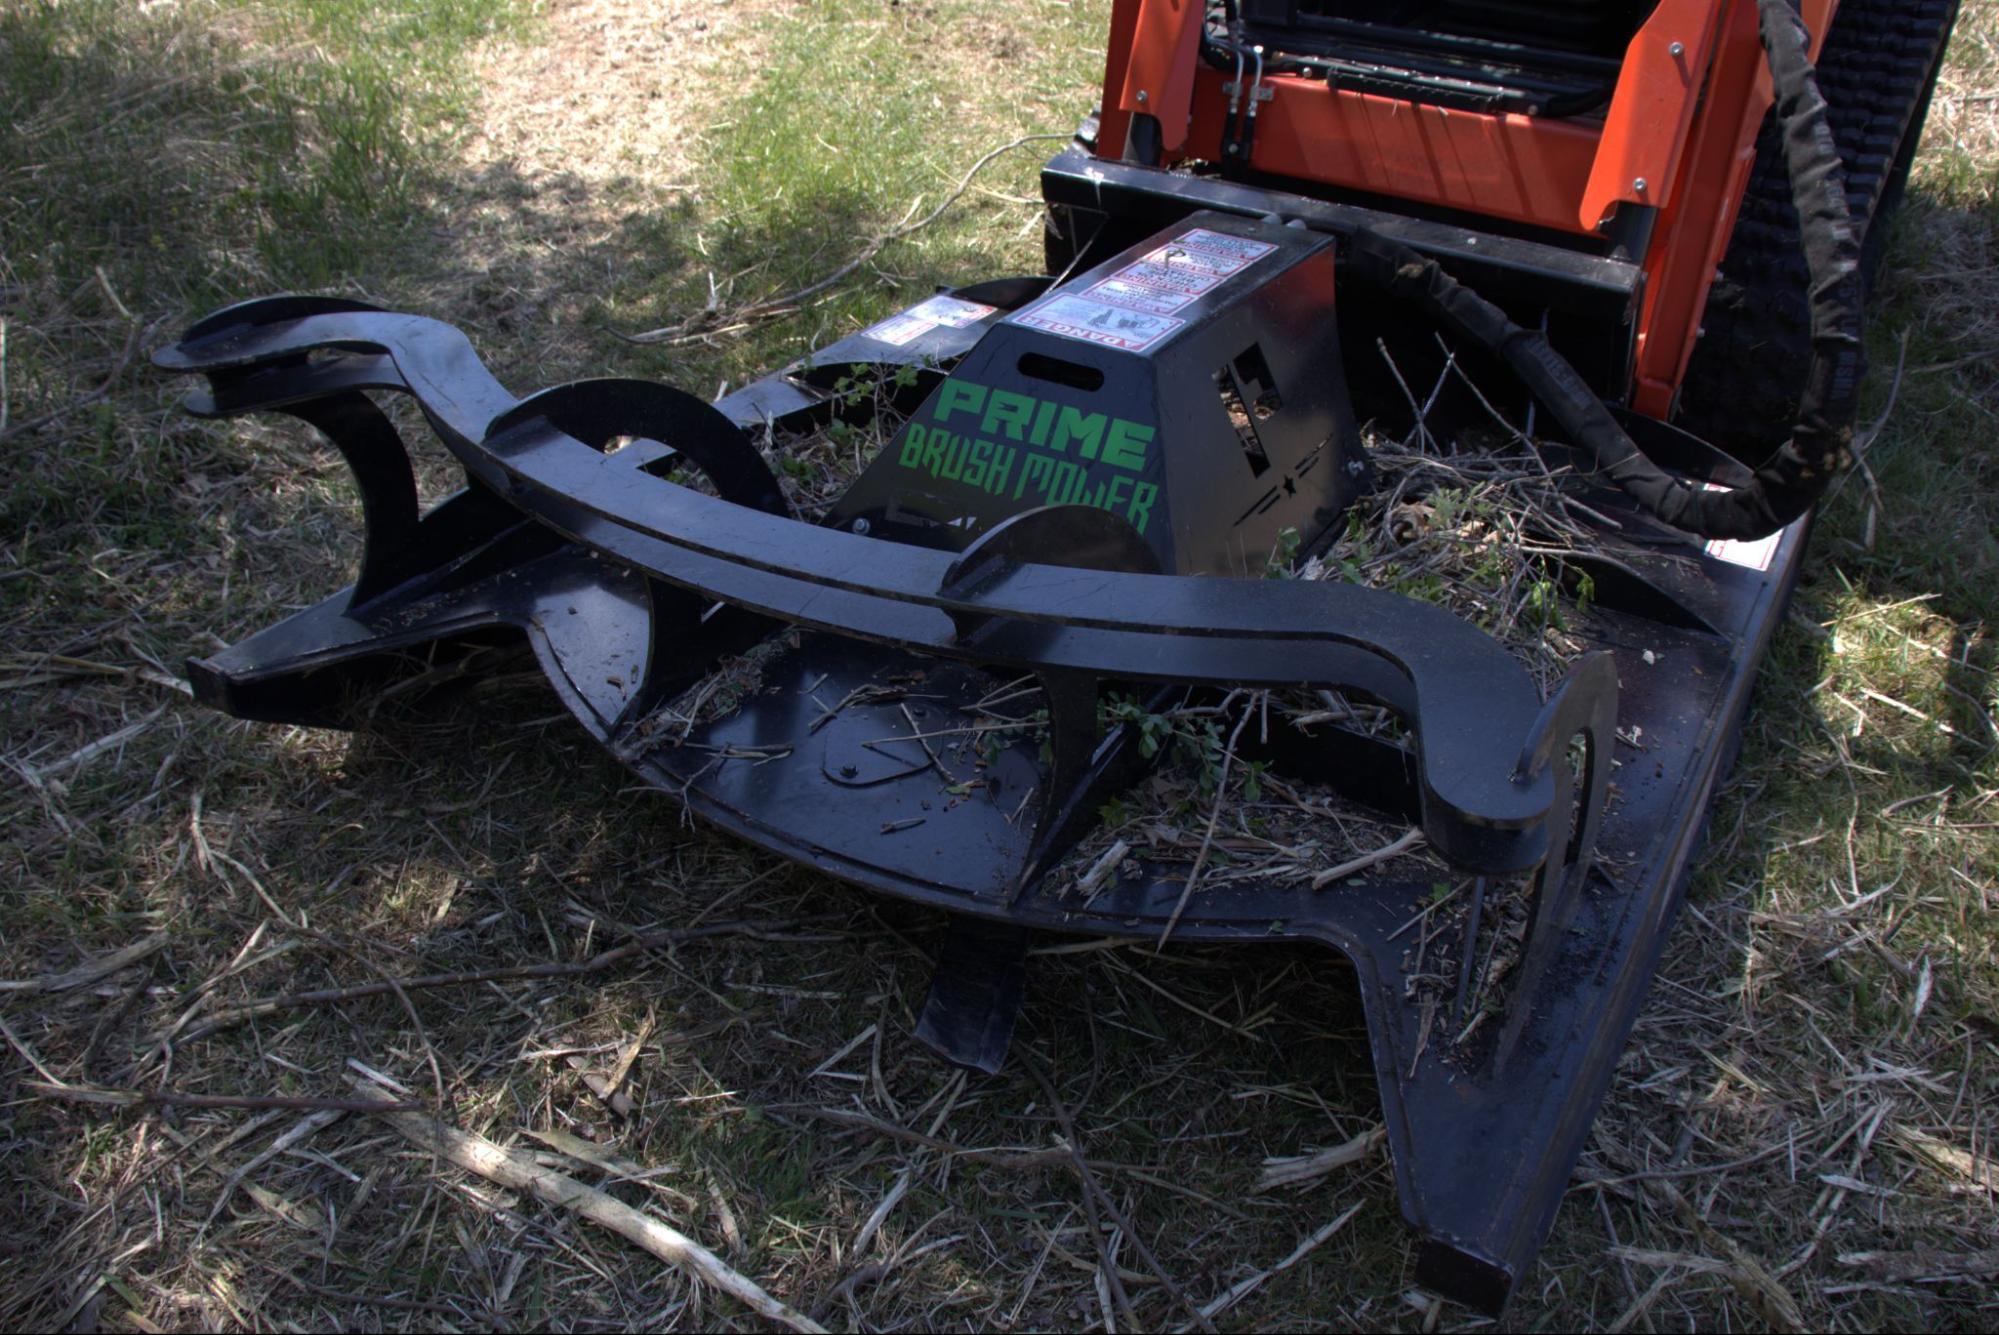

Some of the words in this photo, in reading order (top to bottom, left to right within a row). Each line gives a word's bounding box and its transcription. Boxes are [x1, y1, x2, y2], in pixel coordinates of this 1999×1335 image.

[1021, 317, 1121, 346] DANGER
[934, 377, 1156, 472] PRIME
[898, 422, 1016, 497] BRUSH
[1012, 452, 1159, 535] MOWER
